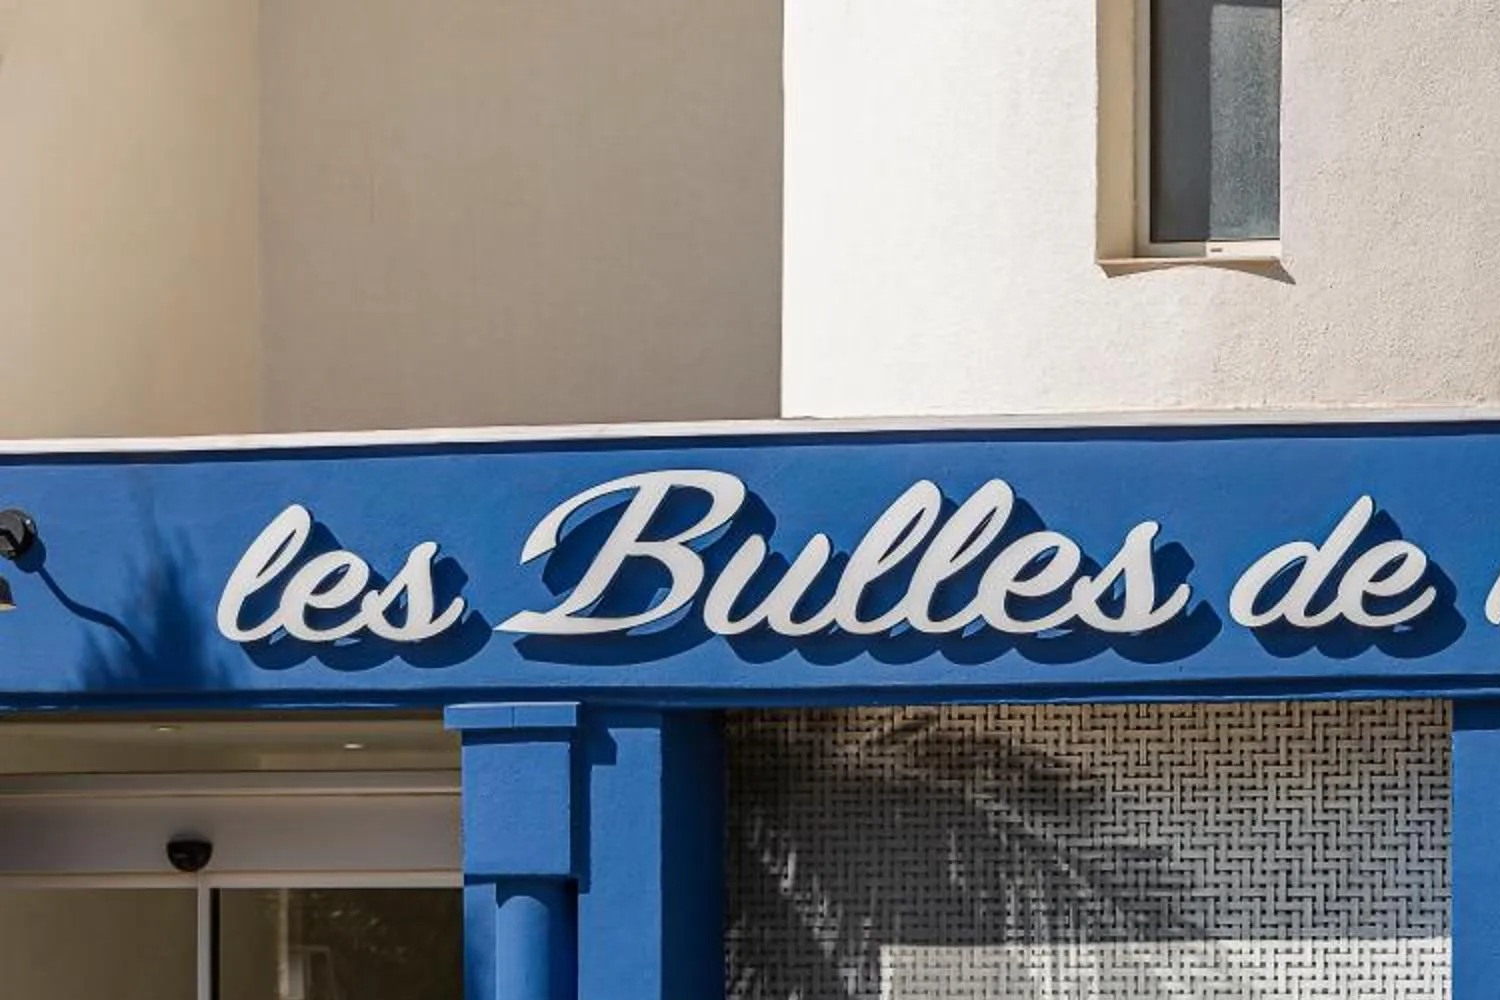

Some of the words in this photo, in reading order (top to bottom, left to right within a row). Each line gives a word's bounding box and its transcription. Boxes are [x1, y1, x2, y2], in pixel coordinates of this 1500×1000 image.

[216, 503, 465, 642] les
[494, 468, 1191, 636] Bulles
[1229, 495, 1437, 627] de
